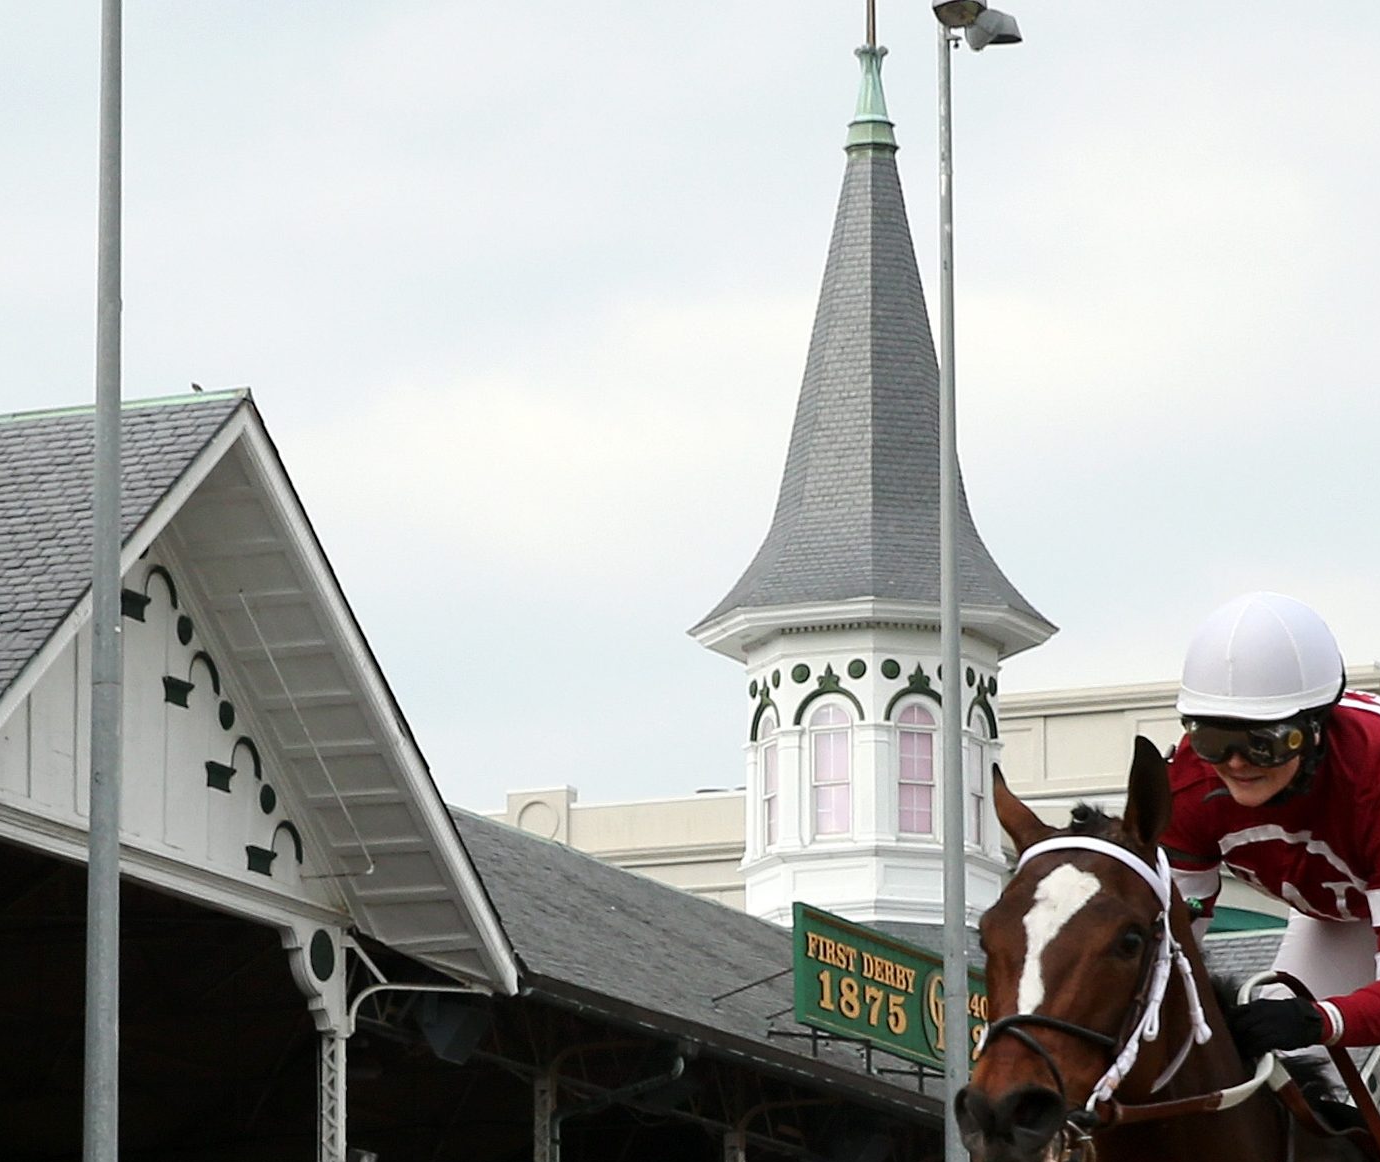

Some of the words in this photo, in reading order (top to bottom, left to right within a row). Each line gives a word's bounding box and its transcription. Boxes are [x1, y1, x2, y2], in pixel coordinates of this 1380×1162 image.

[806, 932, 857, 972] FIRST
[862, 952, 915, 994] DERBY
[819, 970, 907, 1035] 1875
